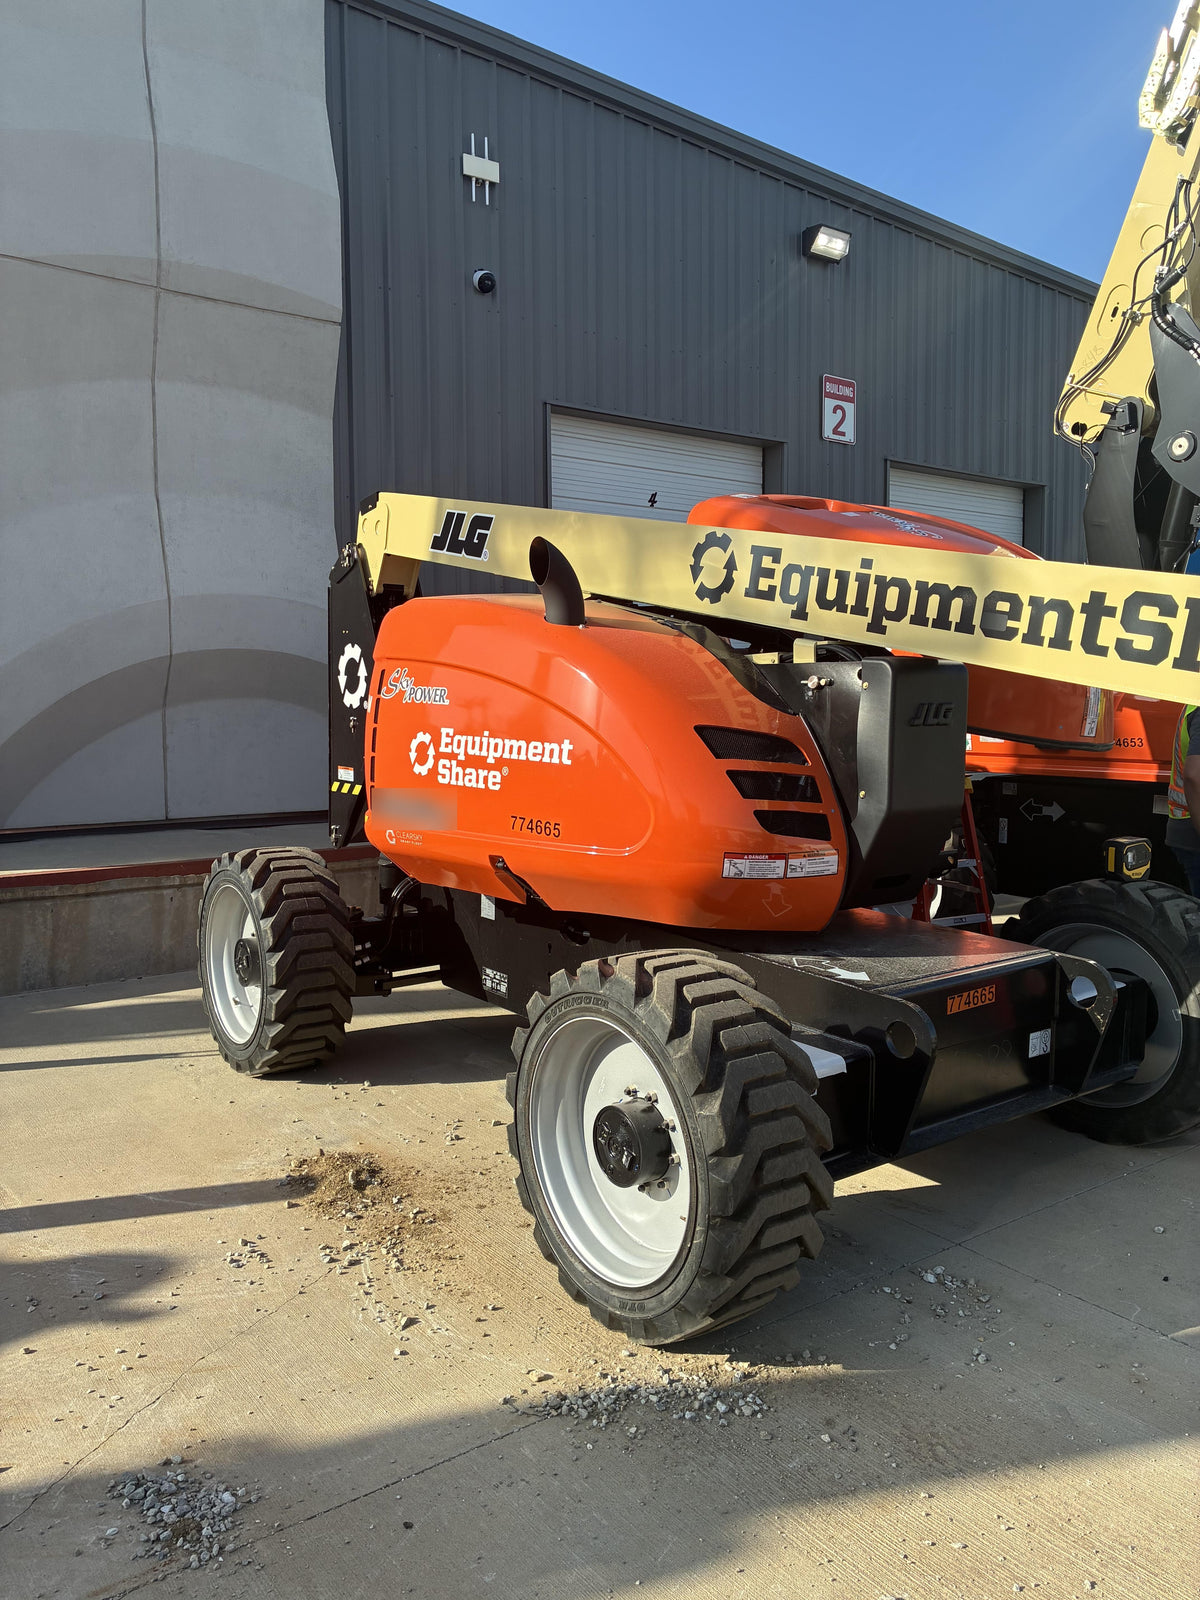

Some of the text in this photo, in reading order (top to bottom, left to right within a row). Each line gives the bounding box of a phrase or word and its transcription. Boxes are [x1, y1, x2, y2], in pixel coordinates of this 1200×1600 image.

[825, 382, 853, 397] BUILDING
[832, 404, 846, 437] 2
[648, 491, 658, 507] 4
[430, 511, 494, 558] JLG
[382, 668, 447, 703] Sky POWER
[439, 727, 573, 765] Equipment
[511, 815, 561, 838] 774665
[949, 986, 995, 1013] 774665
